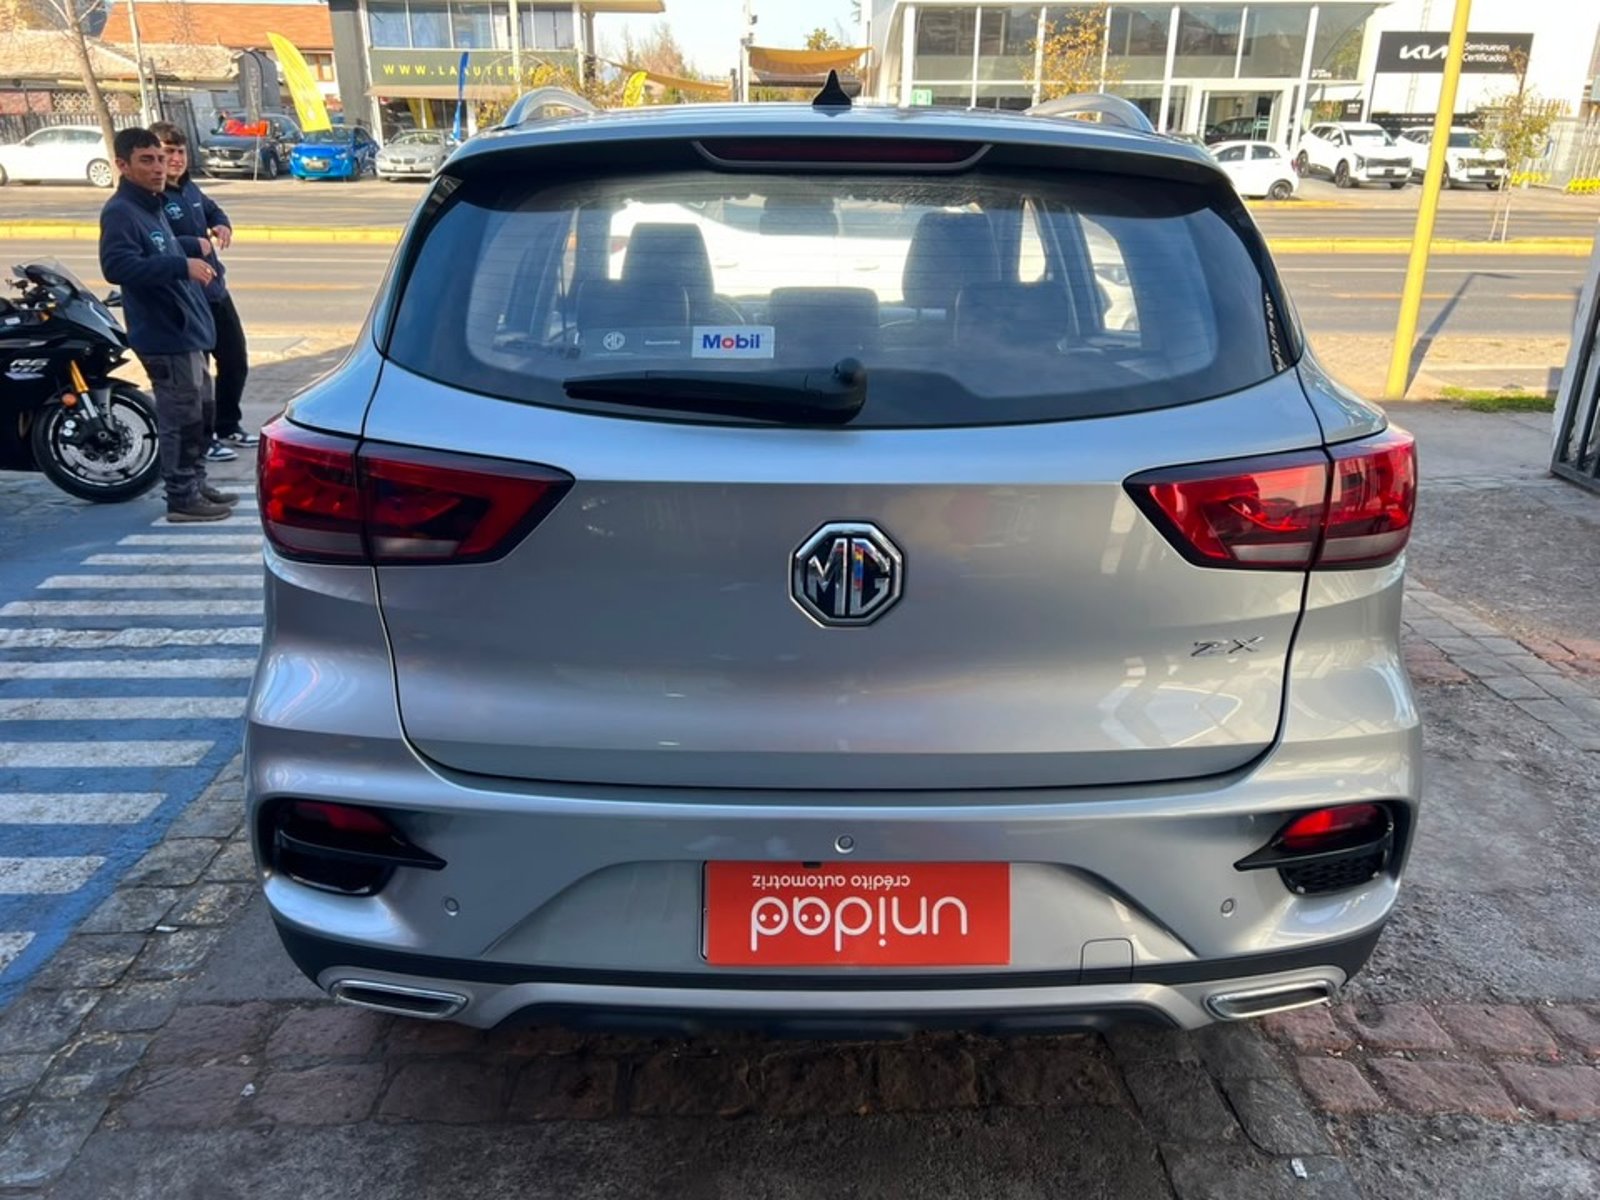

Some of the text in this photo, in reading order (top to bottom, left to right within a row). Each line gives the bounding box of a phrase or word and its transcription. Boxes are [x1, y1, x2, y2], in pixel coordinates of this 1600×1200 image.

[1463, 41, 1510, 52] Seminuevos
[1462, 52, 1508, 63] Certificados
[702, 333, 761, 350] Mobil
[806, 535, 892, 618] MG
[752, 874, 911, 891] crédito automotriz
[751, 896, 968, 952] unidad
